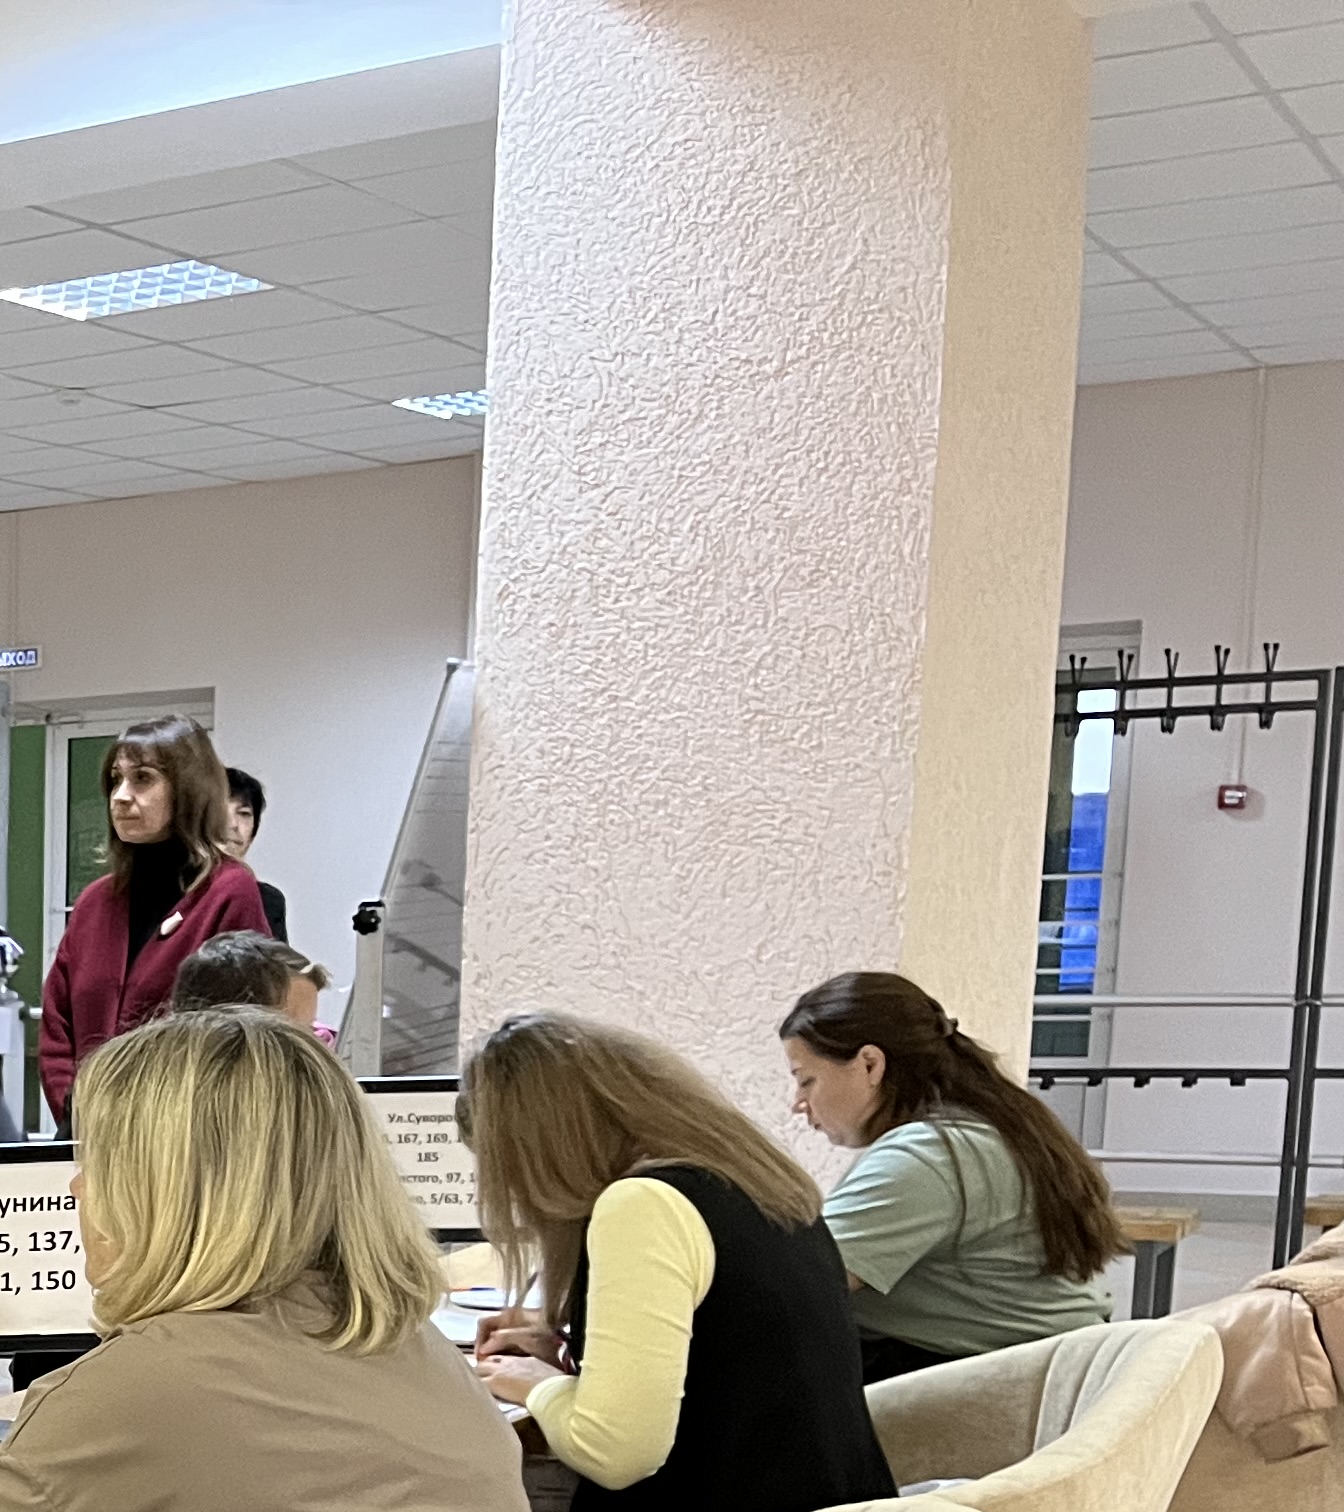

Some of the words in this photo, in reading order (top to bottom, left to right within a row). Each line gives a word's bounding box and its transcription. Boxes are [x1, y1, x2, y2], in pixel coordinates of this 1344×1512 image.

[387, 1112, 455, 1125] Ул.Суворо
[397, 1133, 423, 1145] 167,
[426, 1133, 452, 1145] 169,
[417, 1152, 439, 1163] 185
[401, 1174, 443, 1185] стого,
[446, 1172, 466, 1185] 97,
[28, 1230, 80, 1254] 137,
[31, 1269, 77, 1291] 150
